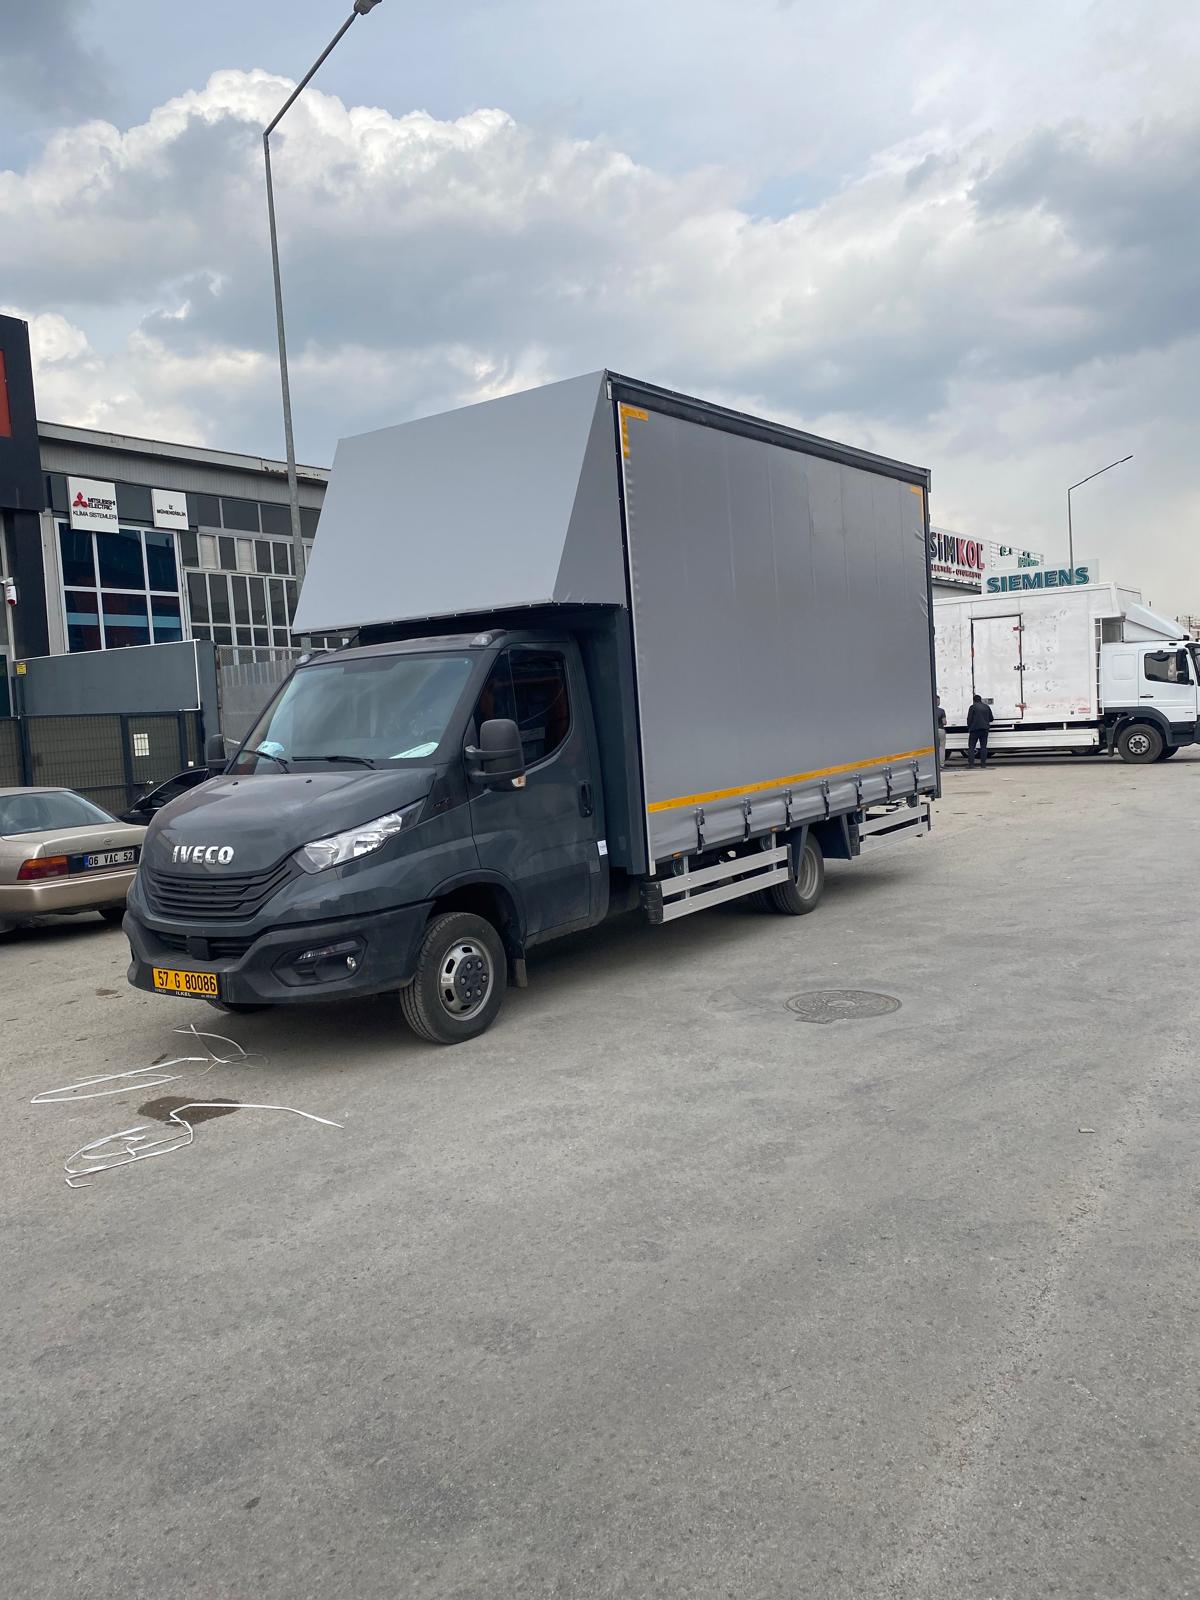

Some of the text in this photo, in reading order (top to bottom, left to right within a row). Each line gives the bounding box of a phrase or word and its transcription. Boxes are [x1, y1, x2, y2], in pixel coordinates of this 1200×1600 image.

[87, 497, 116, 506] MITSUBISHI
[88, 502, 113, 511] ELECTRIC
[986, 566, 1090, 594] SIEMENS
[88, 851, 133, 866] 06 VAC 52
[171, 845, 235, 865] IVECO
[157, 970, 217, 992] 57 G 80086
